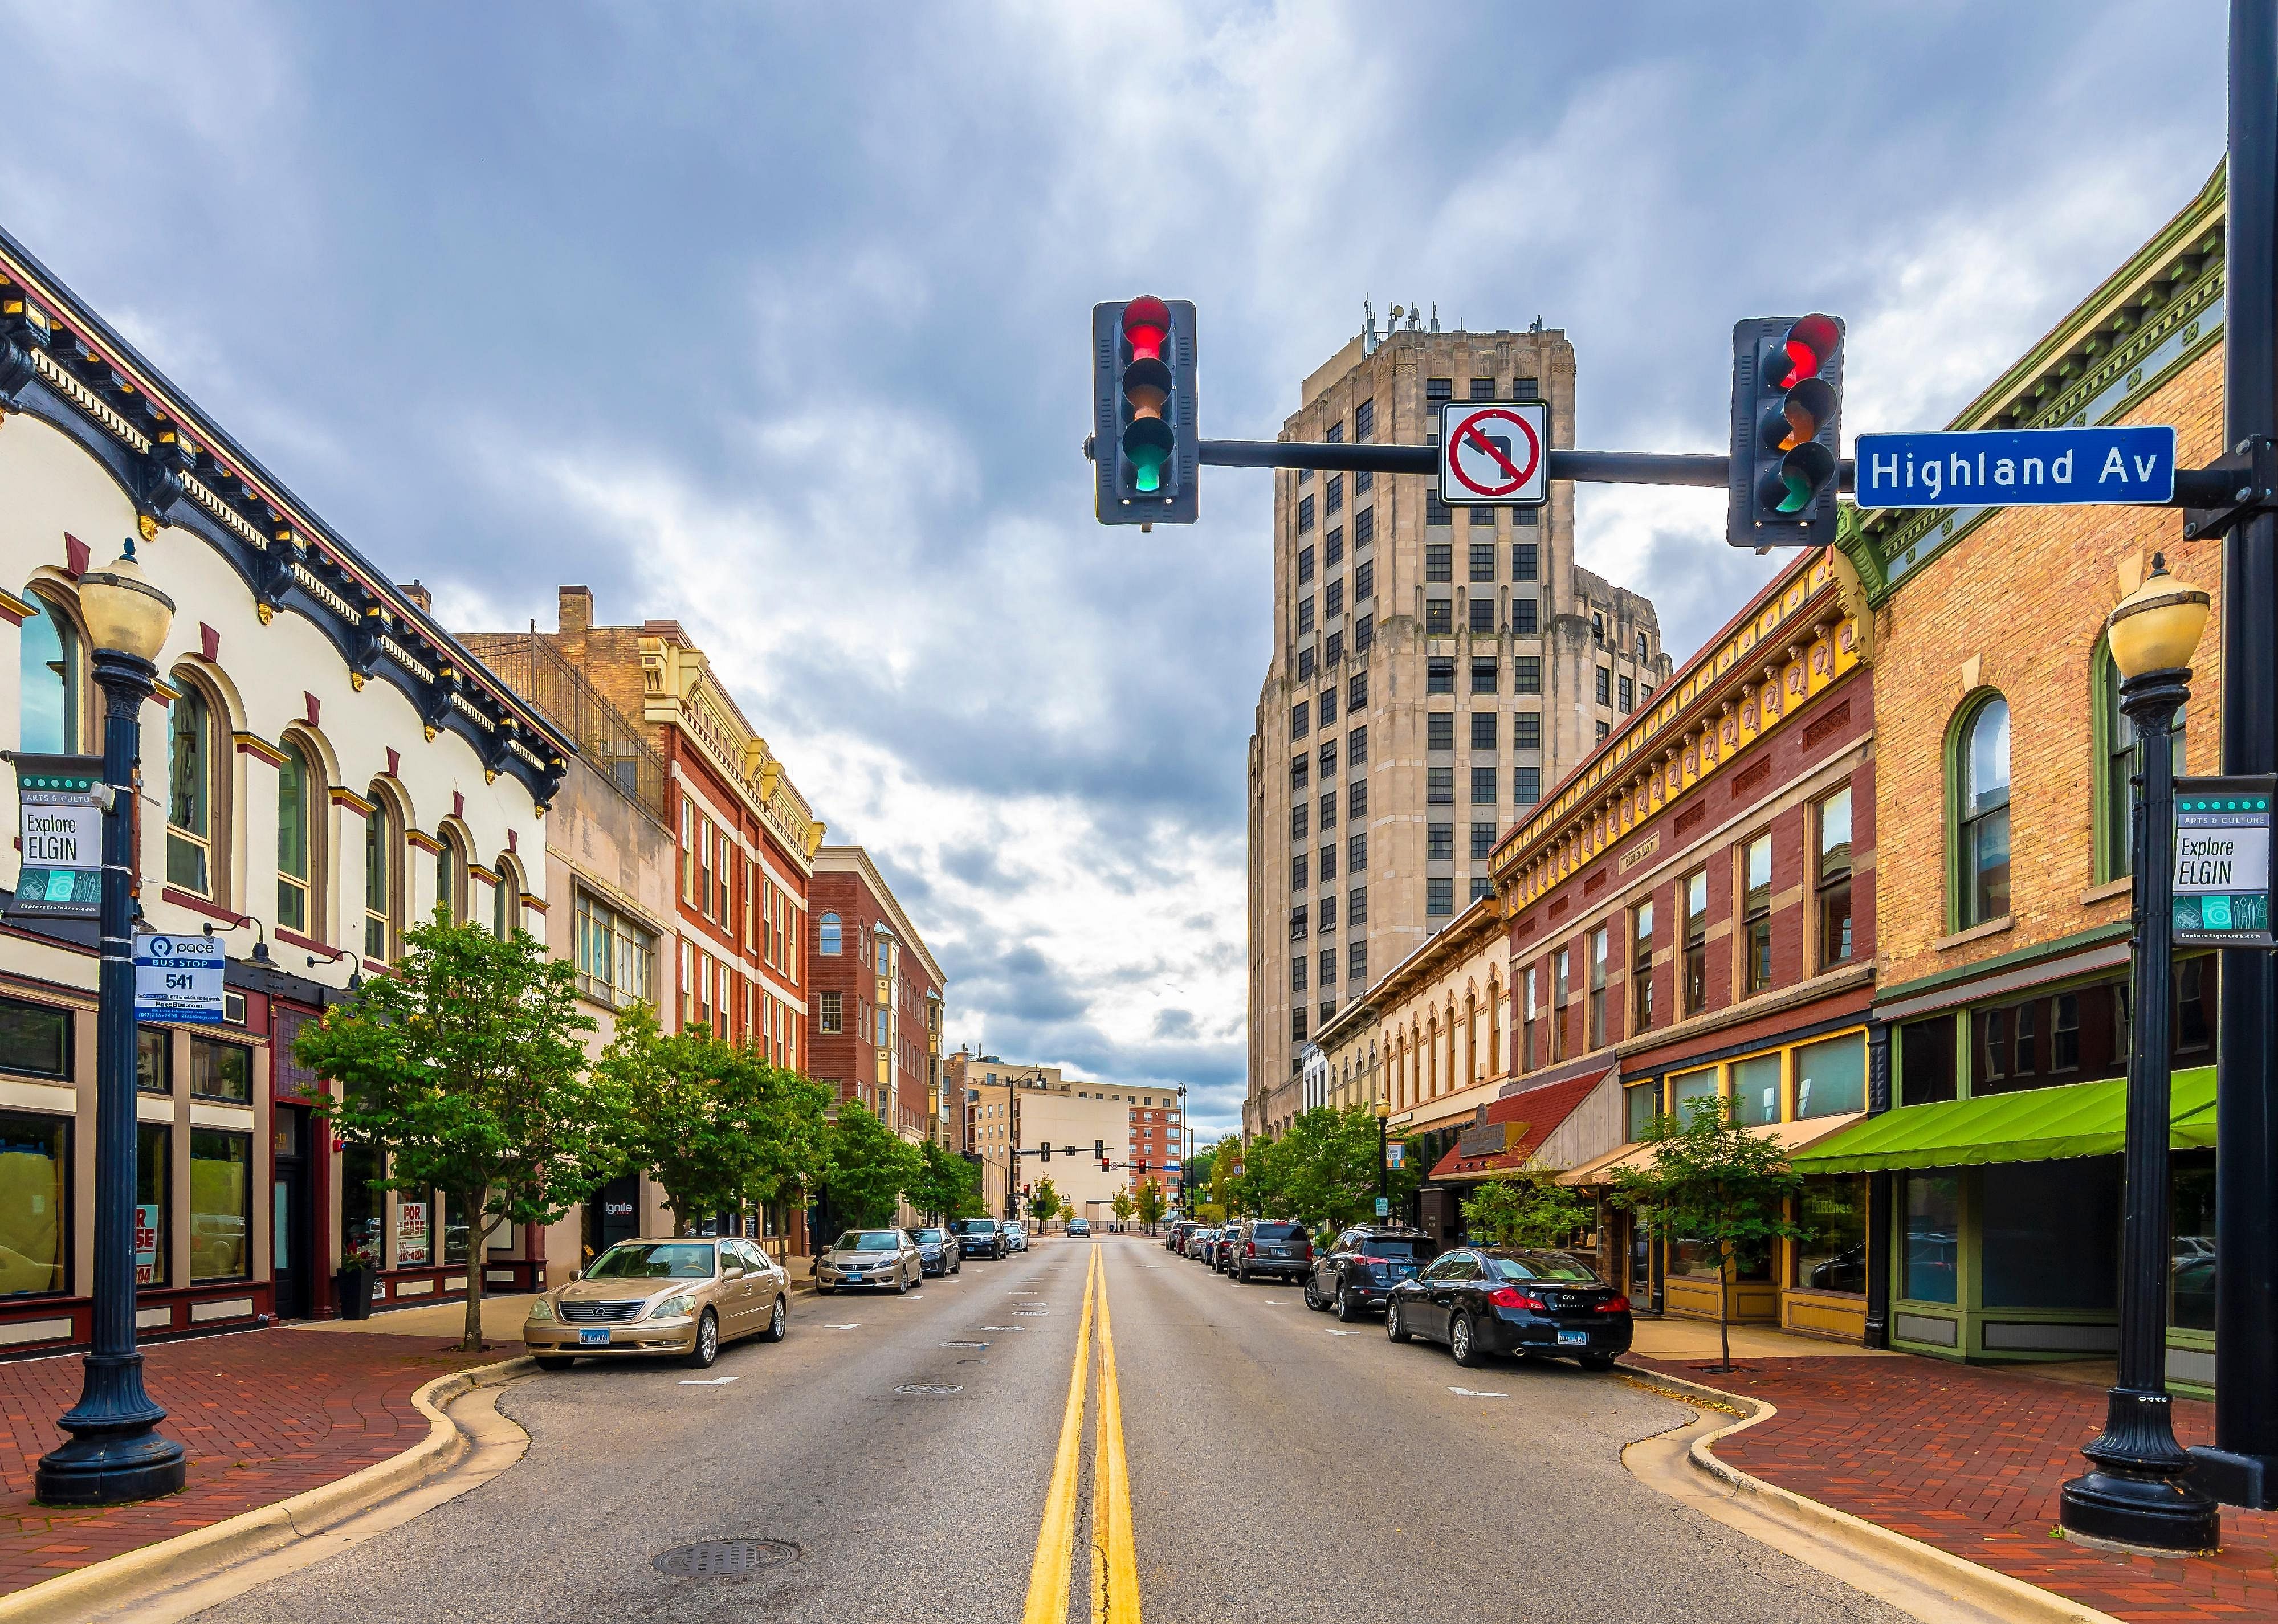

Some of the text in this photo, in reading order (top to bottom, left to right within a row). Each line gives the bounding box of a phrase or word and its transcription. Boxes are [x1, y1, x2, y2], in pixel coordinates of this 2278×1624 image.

[1873, 447, 2157, 499] Highland Av
[27, 814, 76, 836] Explore
[28, 836, 76, 860] ELGIN
[2182, 837, 2234, 860] Explore
[2179, 860, 2232, 885] ELGIN
[177, 942, 215, 954] pace
[166, 973, 193, 989] 541
[404, 1205, 421, 1220] FOR
[605, 1202, 633, 1214] Ignite
[400, 1221, 425, 1236] LEASE
